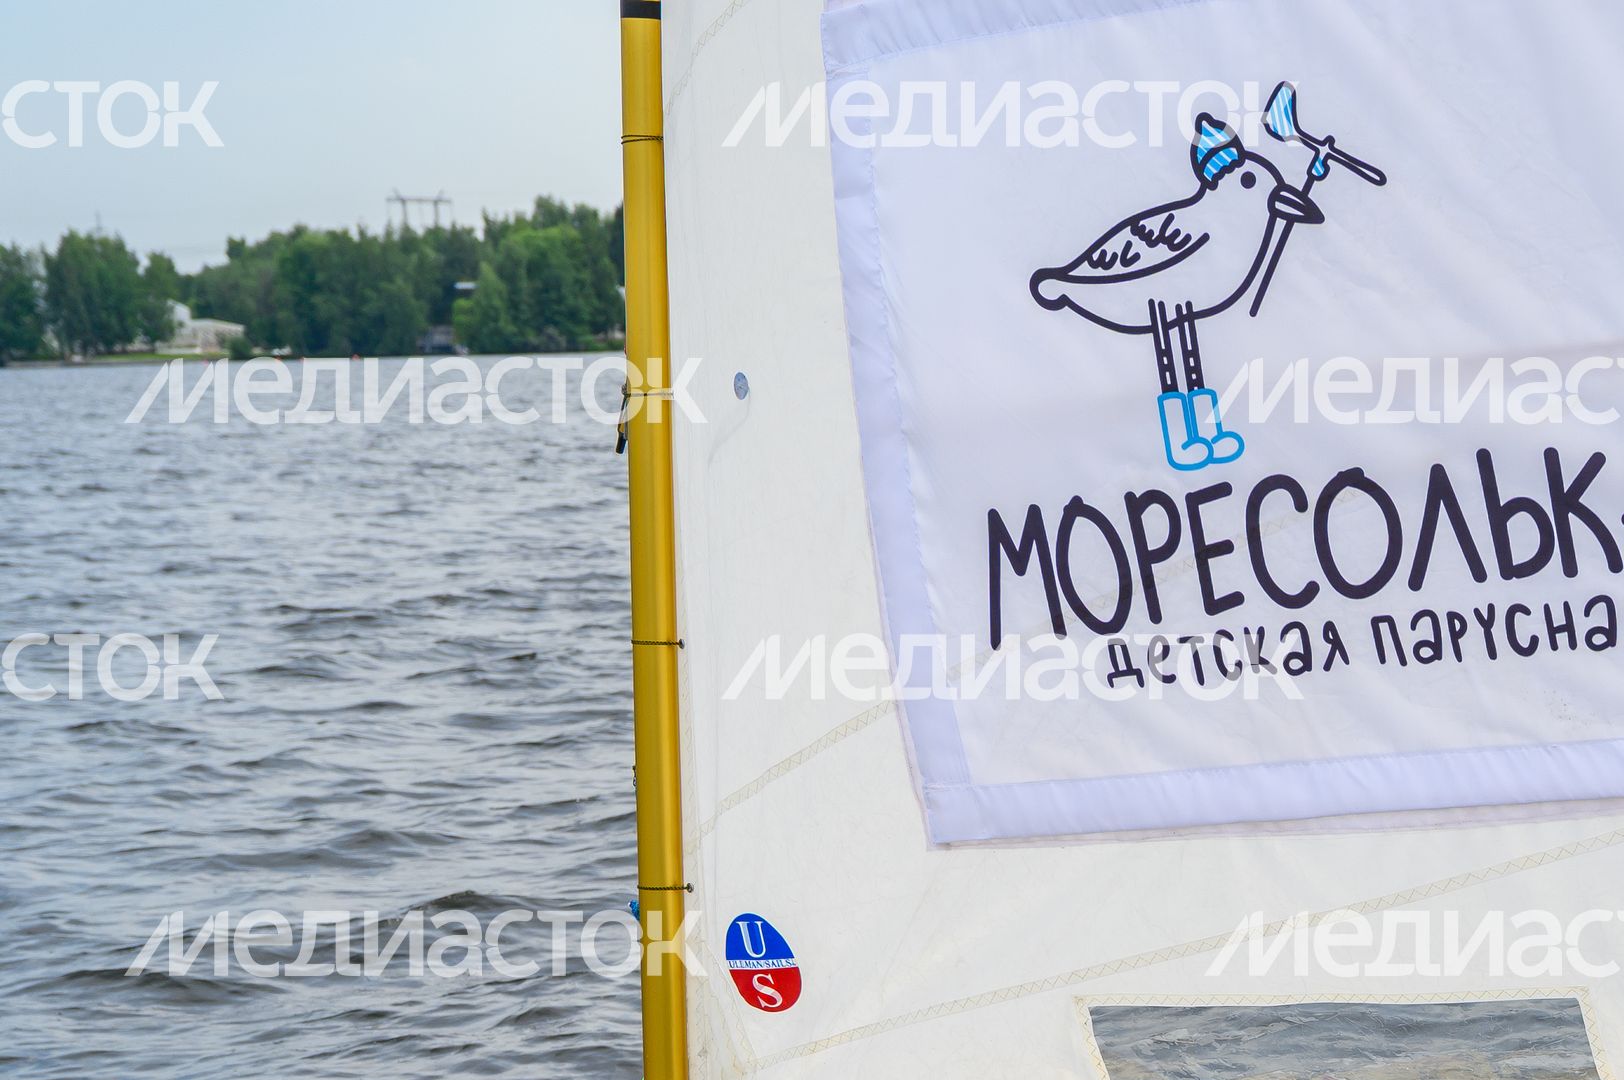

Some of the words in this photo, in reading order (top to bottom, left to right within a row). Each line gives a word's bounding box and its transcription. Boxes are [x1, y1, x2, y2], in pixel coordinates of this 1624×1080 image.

[1106, 618, 1351, 690] детская
[736, 921, 766, 958] U
[752, 973, 782, 1008] S
